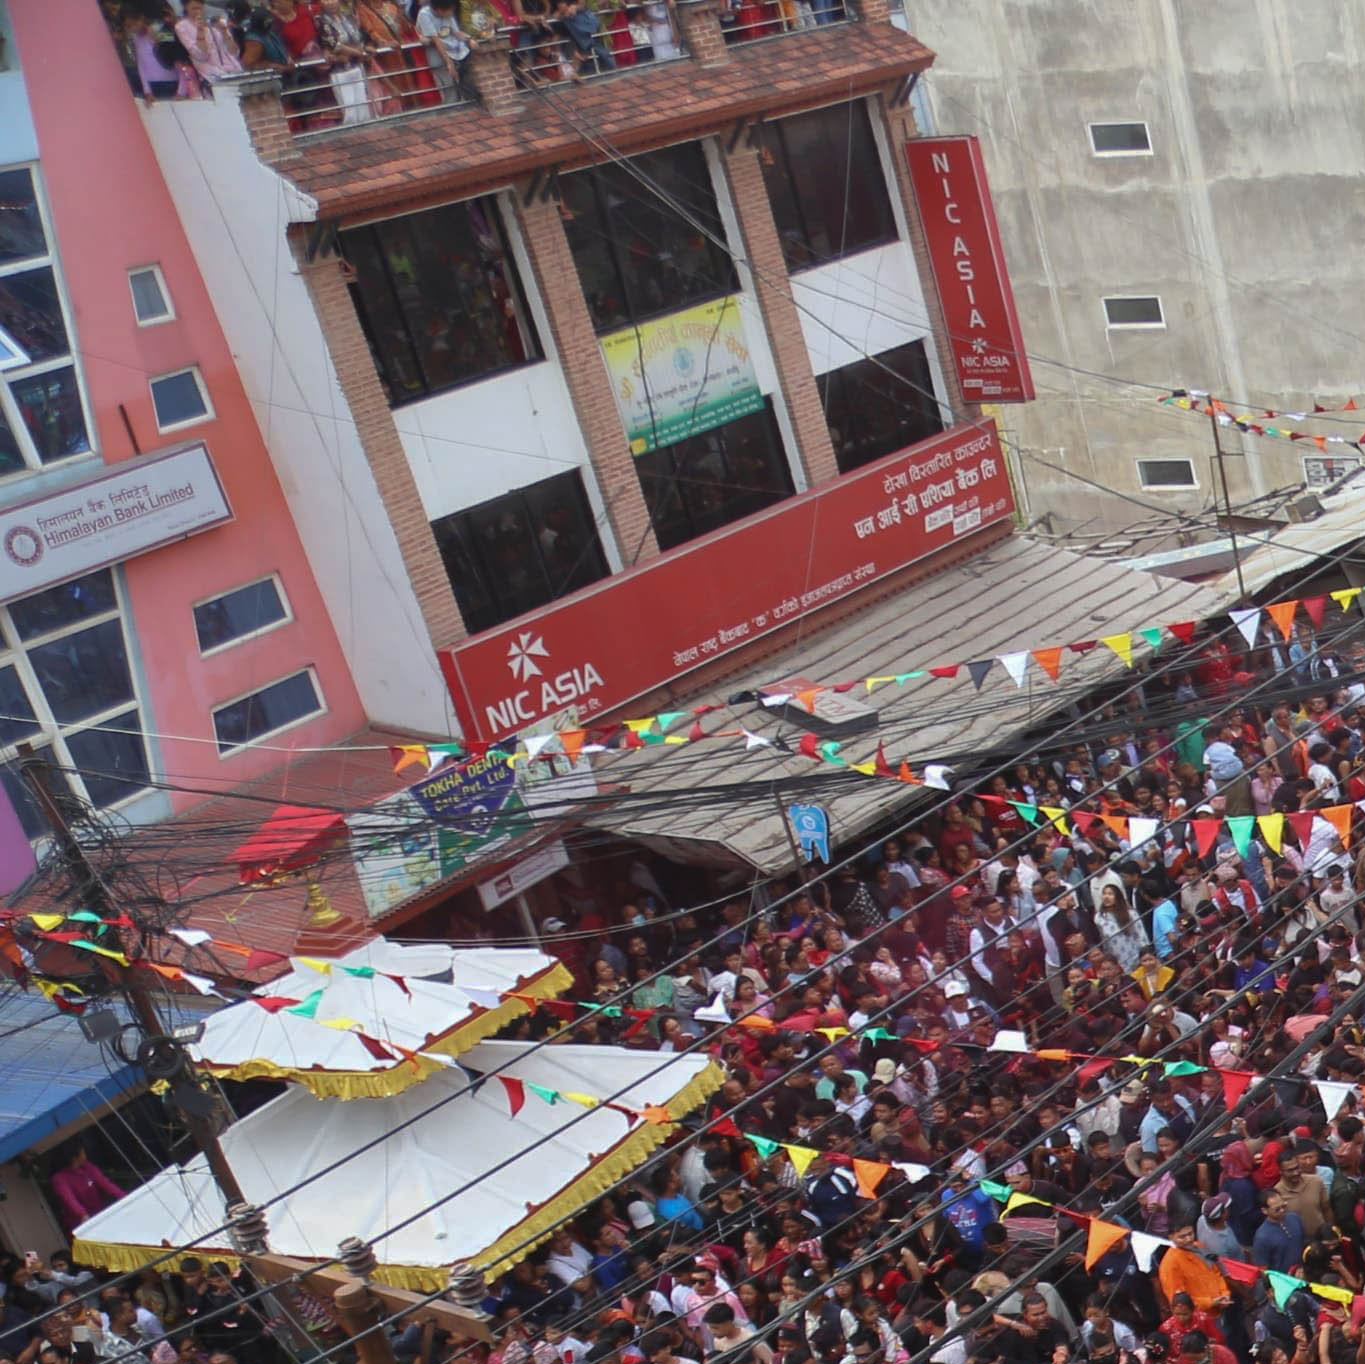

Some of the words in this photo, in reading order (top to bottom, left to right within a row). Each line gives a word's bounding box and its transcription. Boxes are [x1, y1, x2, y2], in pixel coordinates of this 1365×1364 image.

[931, 152, 961, 224] NIC
[953, 236, 986, 329] ASIA
[43, 514, 114, 547] Himalayan
[115, 501, 149, 522] Bank
[151, 483, 194, 509] Limited
[485, 690, 536, 734] NIC
[541, 662, 605, 712] ASIA
[421, 773, 464, 799] TOKHA
